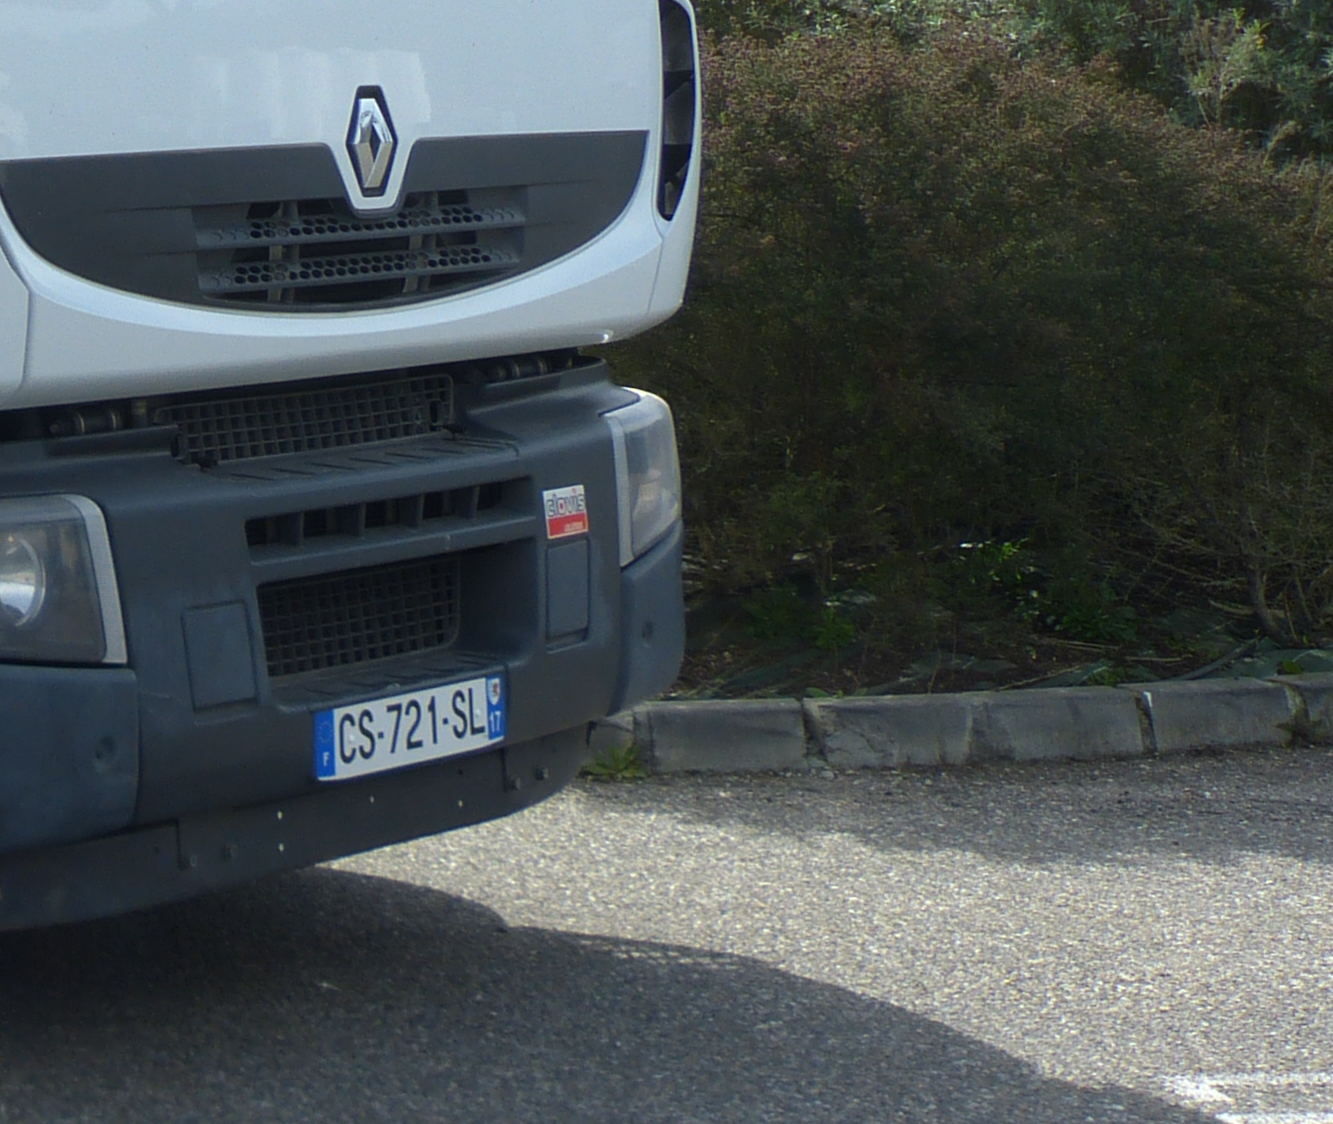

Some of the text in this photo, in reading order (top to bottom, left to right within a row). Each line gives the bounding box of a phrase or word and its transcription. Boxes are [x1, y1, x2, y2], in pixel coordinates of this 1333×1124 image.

[339, 688, 486, 764] CS-721-SL
[489, 711, 501, 734] 17
[322, 752, 328, 766] F
